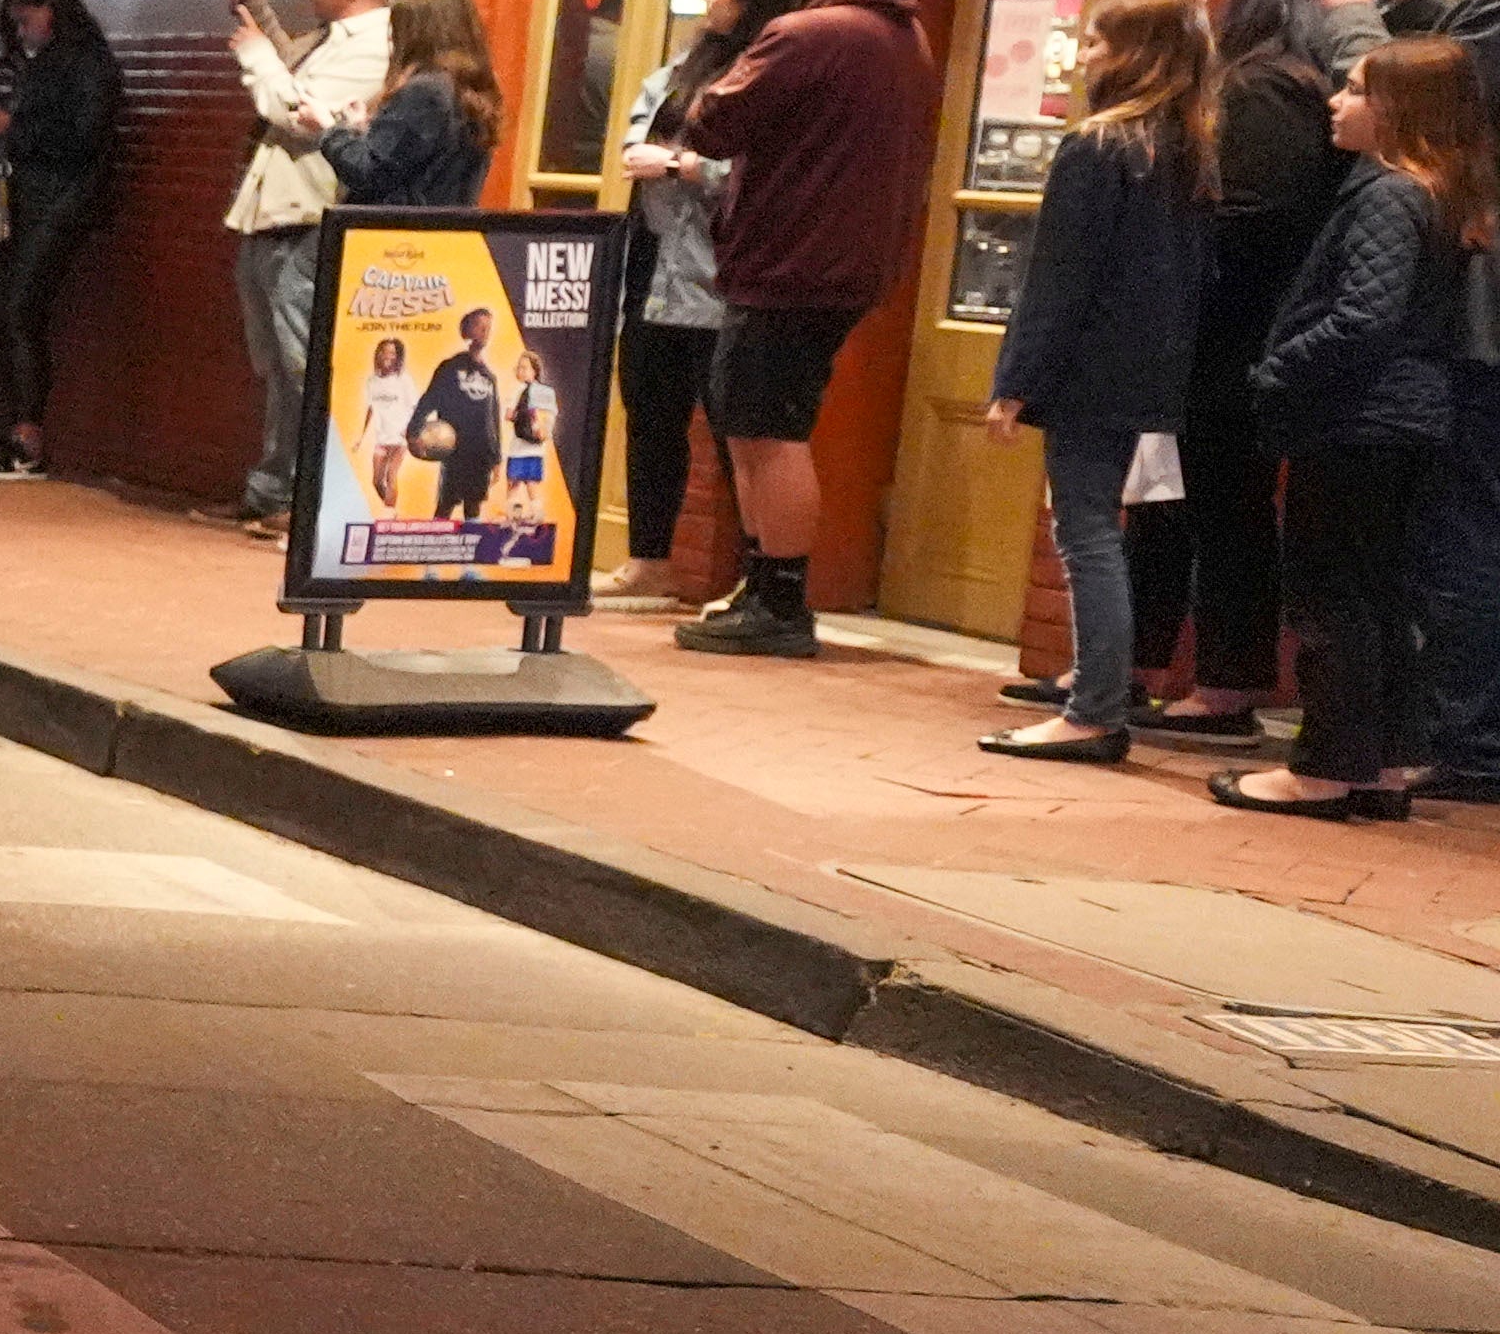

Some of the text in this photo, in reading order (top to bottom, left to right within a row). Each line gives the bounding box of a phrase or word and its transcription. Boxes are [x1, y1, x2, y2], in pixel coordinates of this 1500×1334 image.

[526, 241, 595, 280] NEW
[362, 265, 449, 292] CAPTAIN
[346, 285, 455, 318] MESSI
[524, 280, 592, 312] MESSI
